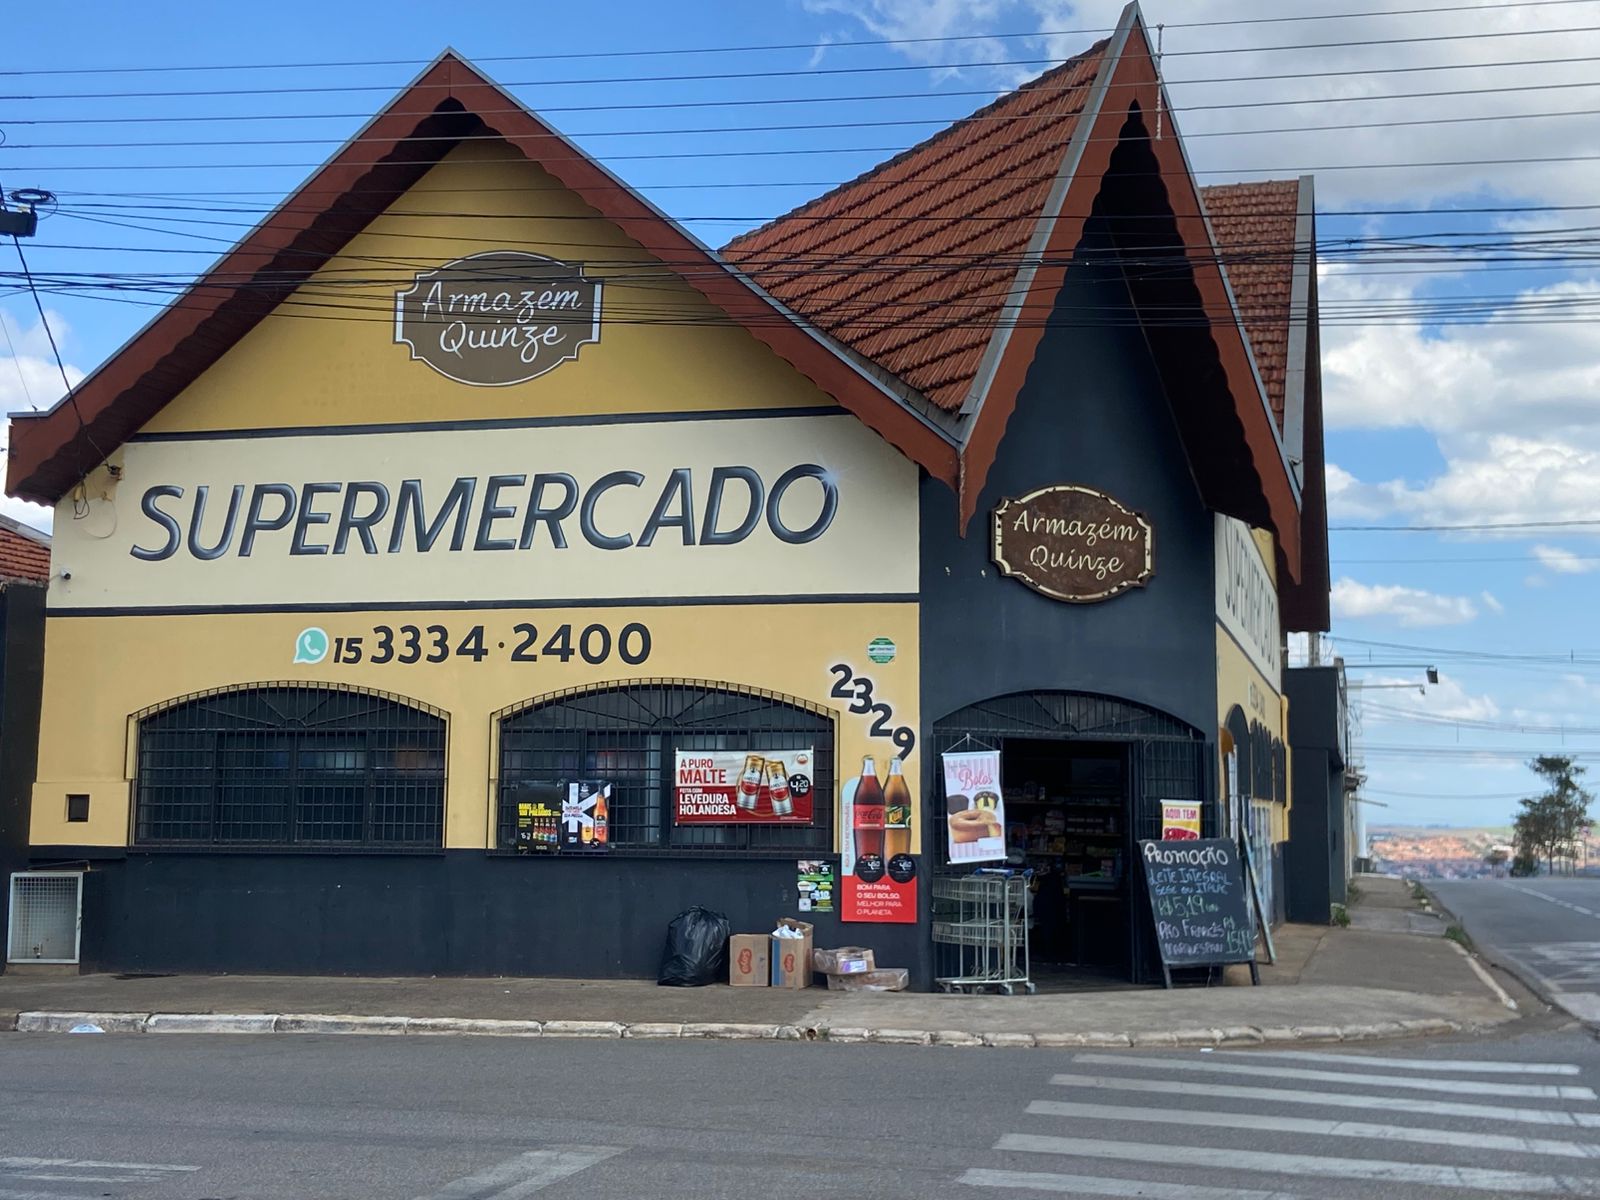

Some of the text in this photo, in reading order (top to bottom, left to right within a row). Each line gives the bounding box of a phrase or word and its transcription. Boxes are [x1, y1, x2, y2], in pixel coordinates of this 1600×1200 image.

[422, 280, 582, 324] Armazém
[439, 320, 568, 363] Quinze
[129, 463, 839, 562] SUPERMERCADO
[1013, 510, 1139, 546] Armazém
[1029, 545, 1125, 581] Quinze
[333, 636, 363, 664] 15
[830, 664, 915, 761] 2329
[680, 758, 713, 768] A PURO
[680, 769, 727, 784] MALTE
[958, 768, 993, 791] Bolos
[679, 804, 737, 815] HOLANDESA
[680, 793, 729, 804] LEVEDURA
[1165, 808, 1197, 819] AQUI TEM
